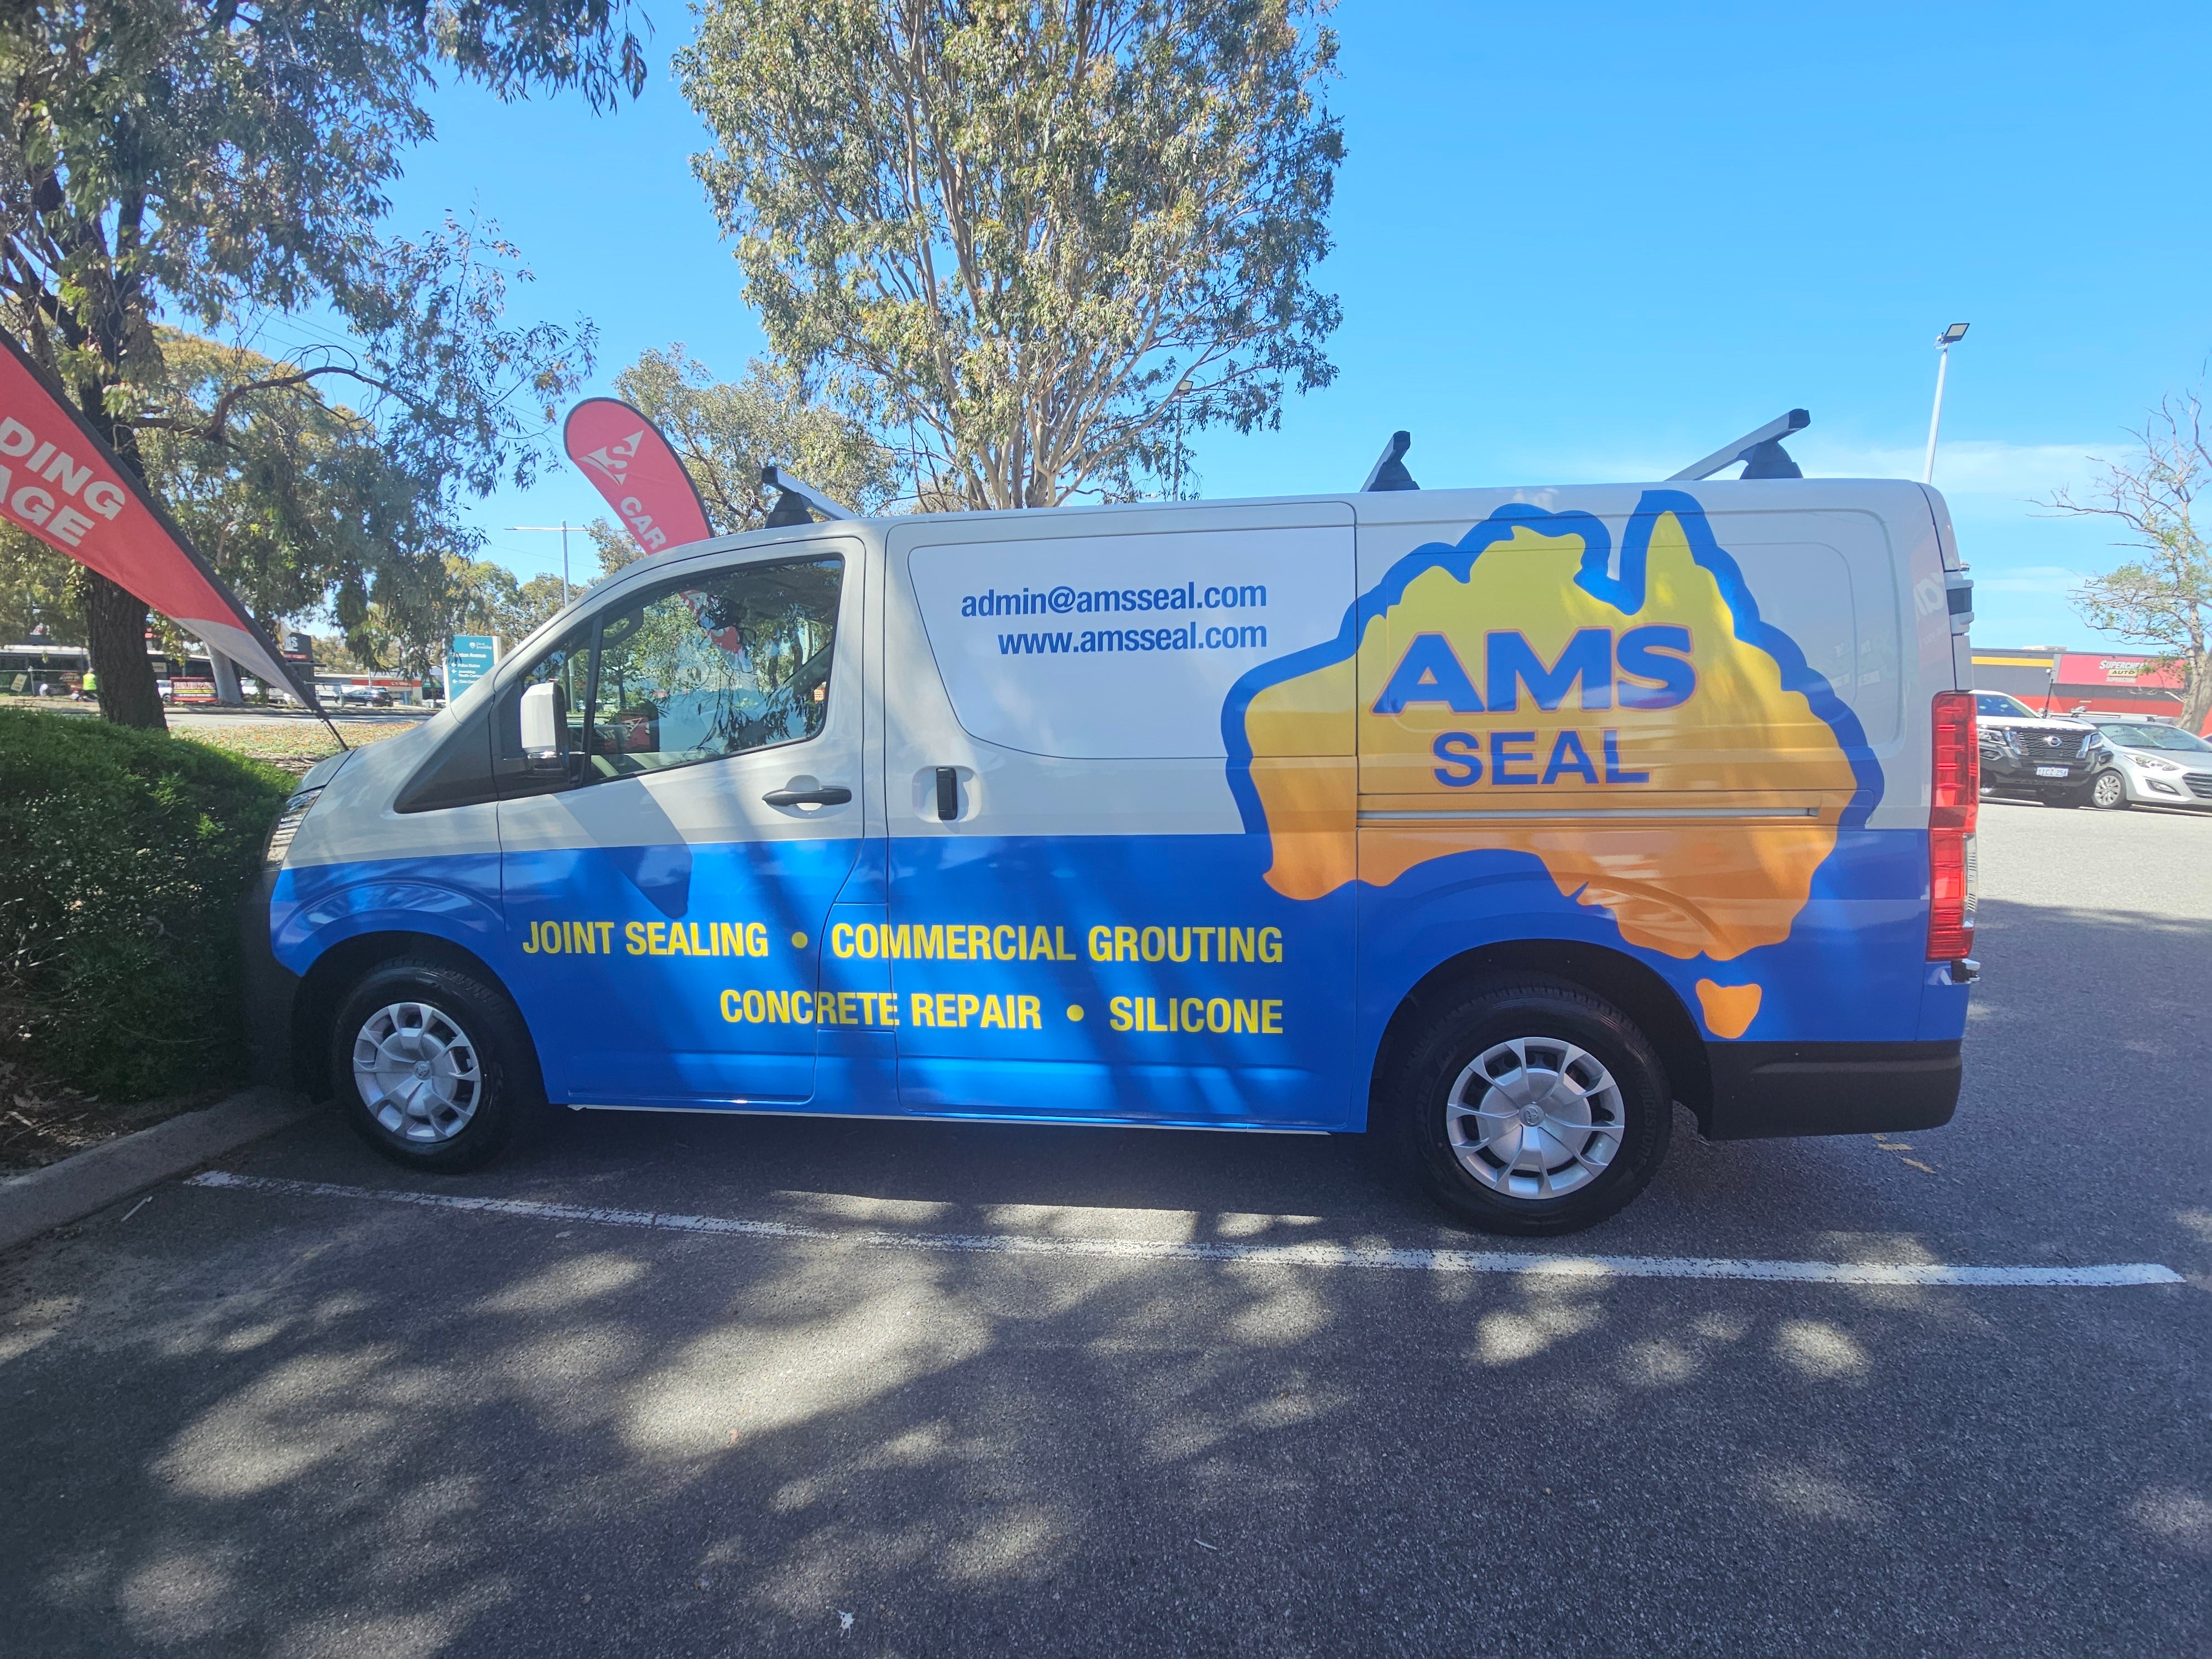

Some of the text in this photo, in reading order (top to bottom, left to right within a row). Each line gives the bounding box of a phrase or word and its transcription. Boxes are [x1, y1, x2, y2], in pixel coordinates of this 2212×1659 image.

[620, 497, 666, 550] CAR
[961, 581, 1267, 617] admin@amsseal.com
[997, 621, 1267, 655] www.amsseal.com
[1370, 623, 1699, 717] AMS
[1432, 728, 1650, 787] SEAL
[522, 921, 1282, 963] JOINT SEALING COMMERCIAL GROUTING
[720, 989, 1283, 1034] CONCRETE REPAIR SILICONE
